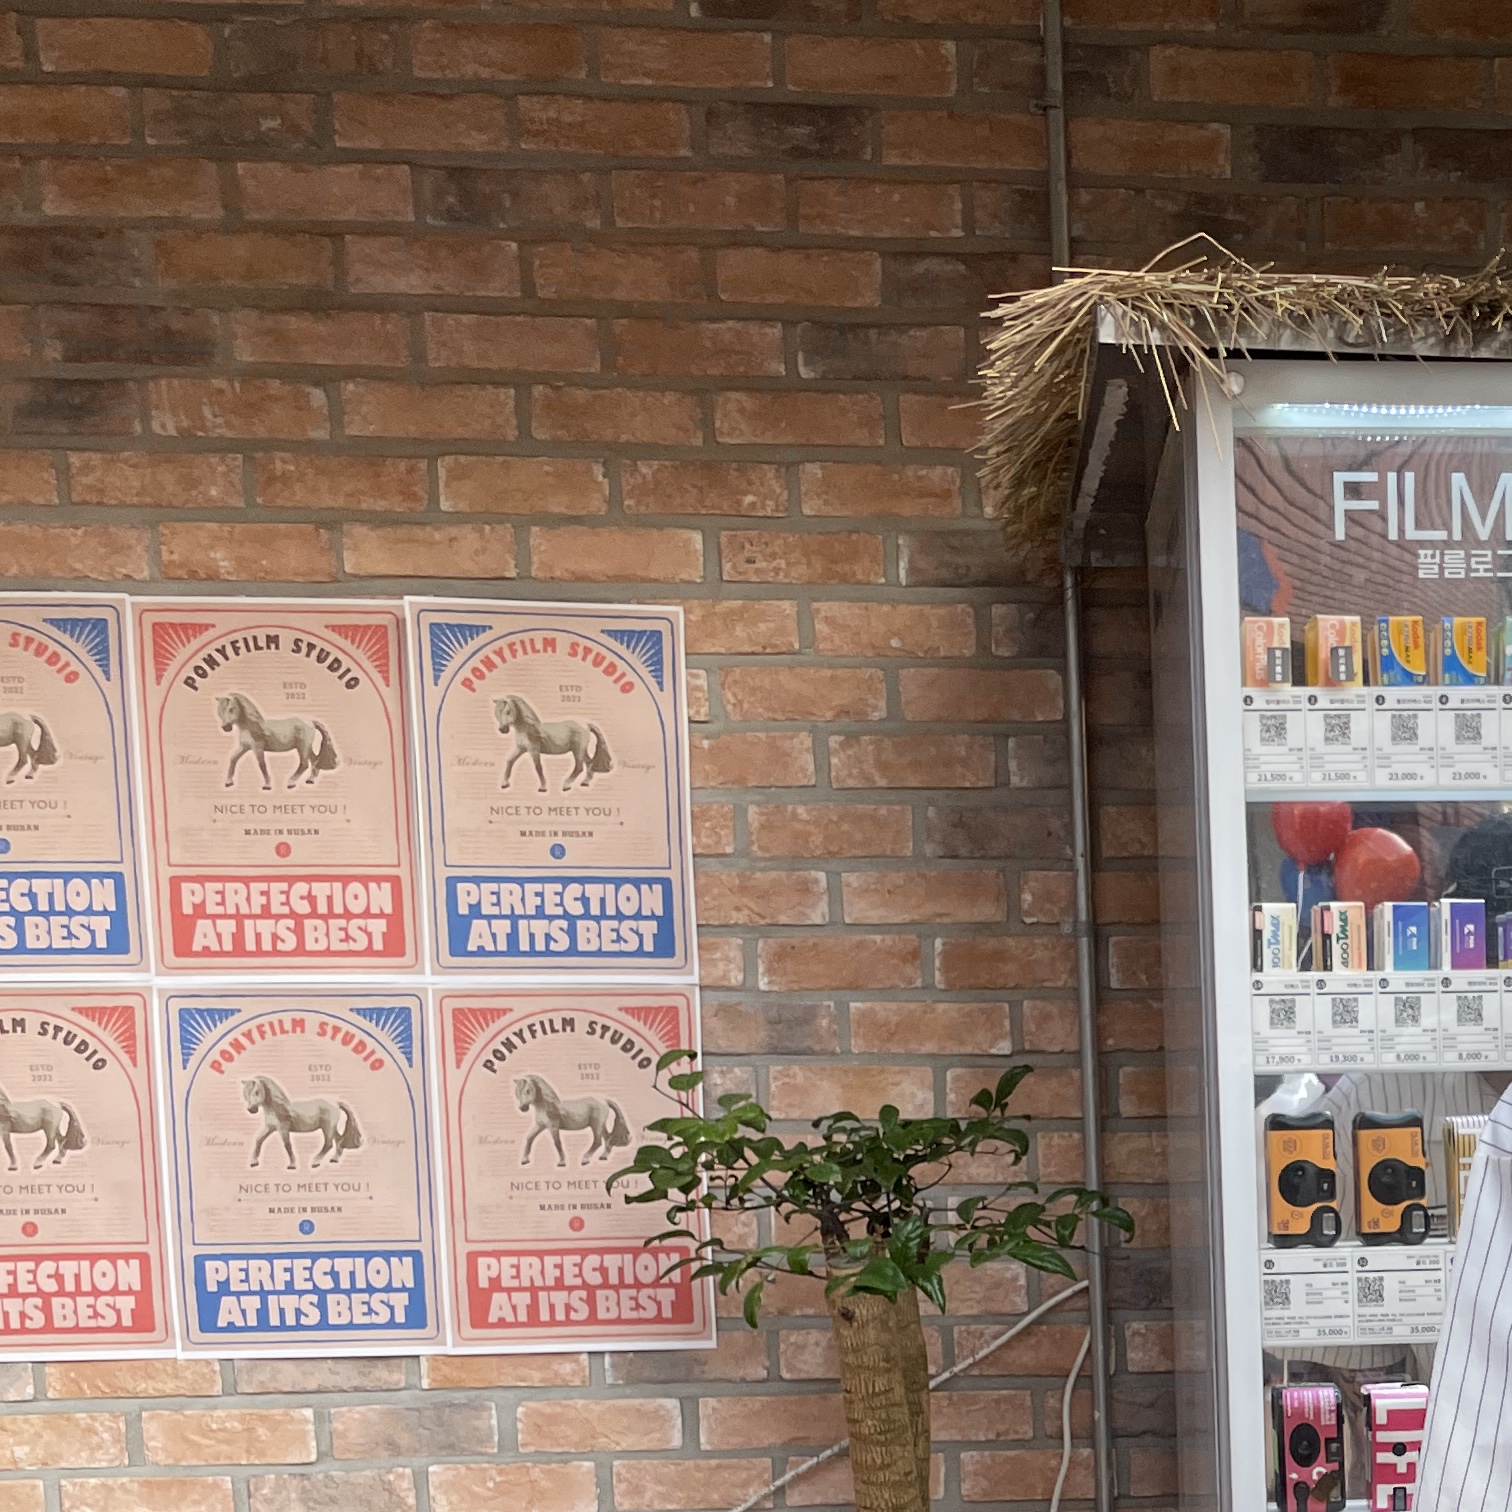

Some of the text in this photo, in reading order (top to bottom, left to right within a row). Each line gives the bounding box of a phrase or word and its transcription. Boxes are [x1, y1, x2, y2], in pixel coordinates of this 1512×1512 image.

[1254, 622, 1267, 680] ColorPlus
[1411, 619, 1422, 650] Kodak
[1475, 621, 1484, 653] Kodak
[8, 631, 81, 684] STUDIO
[183, 634, 361, 692] PONYFILM STUDIO
[460, 637, 636, 694] PONYFILM STUDIO
[31, 800, 58, 811] YOU
[213, 804, 246, 815] NICE
[249, 804, 268, 815] TO
[273, 804, 309, 815] MEET
[310, 804, 339, 815] YOU
[490, 806, 522, 817] NICE
[526, 806, 543, 817] TO
[548, 806, 579, 817] MEET
[583, 807, 613, 817] YOU
[244, 828, 272, 836] MADE
[287, 828, 320, 836] BUSAN
[520, 830, 547, 838] MADE
[562, 830, 594, 838] BUSAN
[180, 882, 393, 915] PERFECTION
[456, 883, 664, 916] PERFECTION
[24, 916, 111, 949] BEST
[192, 919, 387, 952] AT ITS BEST
[467, 919, 658, 953] AT ITS BEST
[37, 1021, 108, 1071] STUDIO
[209, 1018, 385, 1075] PONYFILM STUDIO
[482, 1017, 653, 1074] PONYFILM STUDIO
[19, 1184, 87, 1195] MEET YOU
[239, 1183, 270, 1194] NICE
[275, 1183, 292, 1194] TO
[297, 1182, 329, 1193] MEET
[333, 1182, 361, 1193] YOU
[510, 1181, 540, 1192] NICE
[545, 1181, 562, 1191] TO
[567, 1181, 598, 1191] MEET
[33, 1208, 67, 1216] BUSAN
[268, 1207, 295, 1215] MADE
[311, 1206, 343, 1214] BUSAN
[539, 1204, 565, 1212] MADE
[580, 1203, 612, 1211] BUSAN
[205, 1257, 415, 1292] PERFECTION
[477, 1253, 682, 1288] PERFECTION
[51, 1295, 136, 1329] BEST
[216, 1292, 409, 1328] AT ITS BEST
[488, 1288, 676, 1323] AT ITS BEST
